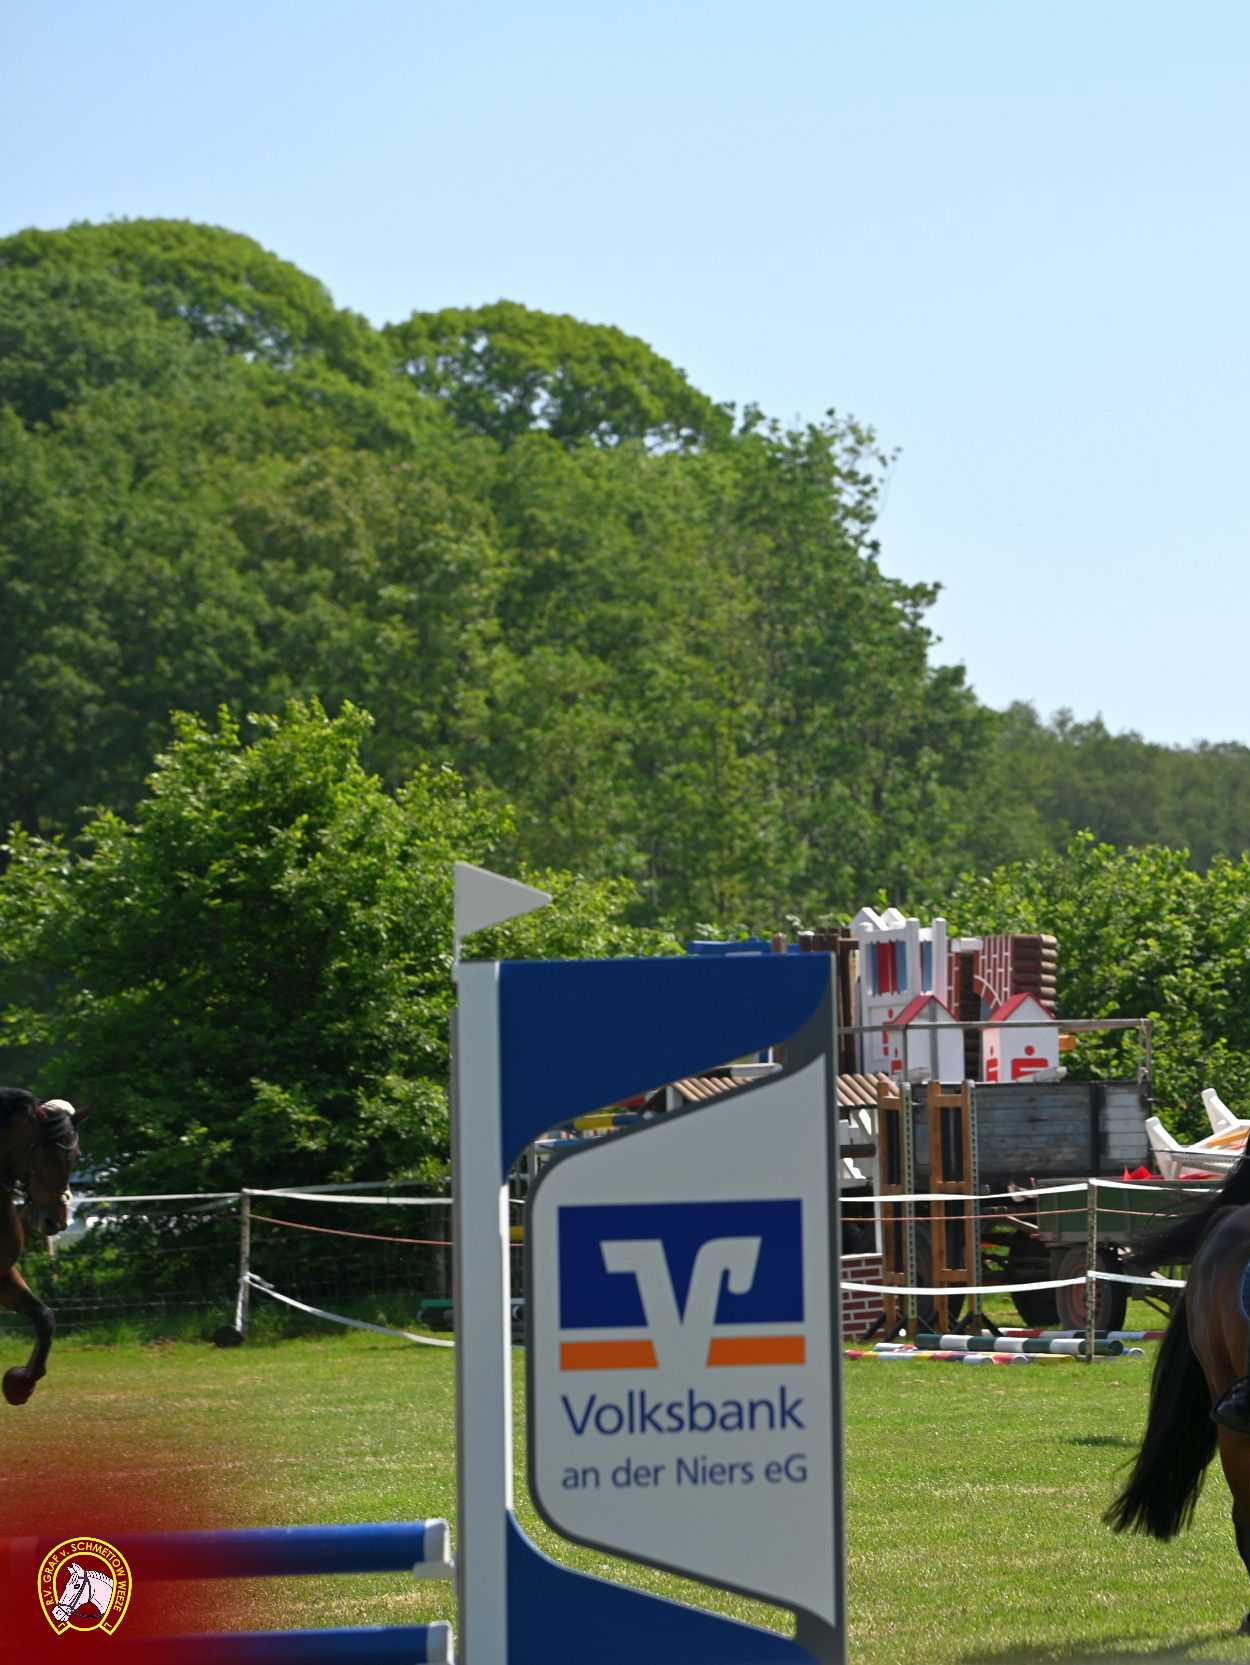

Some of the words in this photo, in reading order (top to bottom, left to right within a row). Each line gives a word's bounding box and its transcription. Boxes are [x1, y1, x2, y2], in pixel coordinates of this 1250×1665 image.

[561, 1385, 806, 1436] Volksbank
[561, 1466, 599, 1490] an
[611, 1457, 665, 1488] der
[676, 1454, 754, 1487] Niers
[764, 1453, 808, 1484] eG
